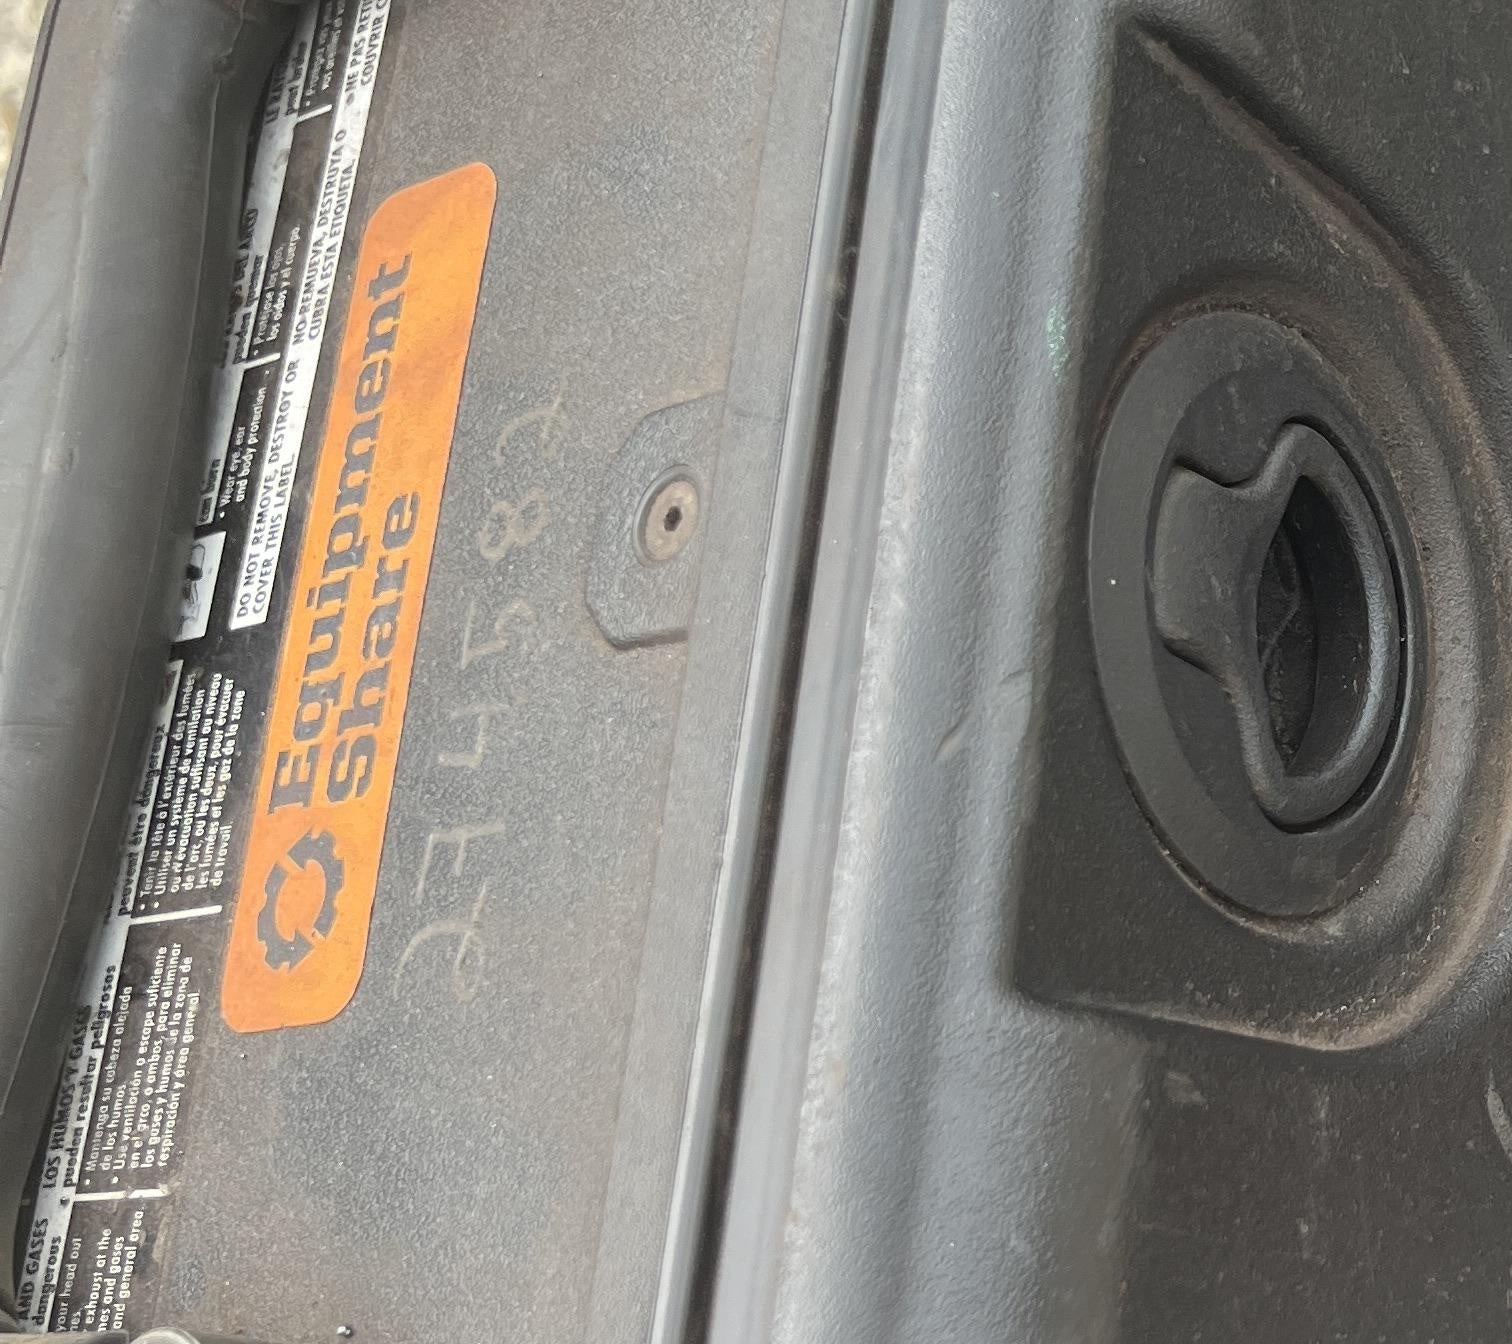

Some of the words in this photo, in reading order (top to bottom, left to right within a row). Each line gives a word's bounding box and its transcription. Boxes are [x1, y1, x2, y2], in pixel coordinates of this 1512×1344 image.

[348, 38, 365, 67] PAS
[359, 14, 385, 86] COUVRIR
[344, 71, 359, 91] NE
[333, 129, 347, 141] O
[316, 145, 344, 227] DESTRUYA
[328, 158, 355, 237] ETIQUETA.
[298, 230, 327, 314] REMUEVA,
[319, 242, 338, 280] ESTA
[307, 282, 330, 340] CUBRA
[292, 319, 308, 344] NO
[284, 358, 300, 383] OR
[267, 389, 294, 463] DESTROY
[218, 474, 236, 507] Wear
[234, 425, 246, 445] ear
[237, 446, 257, 477] body
[232, 478, 248, 503] and
[273, 454, 295, 507] LABEL.
[251, 468, 279, 545] REMOVE,
[264, 513, 283, 551] THIS
[268, 255, 412, 813] Equipment
[242, 551, 260, 586] NOT
[251, 556, 274, 614] COVER
[236, 592, 252, 618] DO
[326, 490, 423, 803] Share
[203, 672, 222, 715] niveau
[213, 677, 235, 727] évacuer
[230, 689, 246, 721] zone
[170, 719, 186, 741] des
[181, 688, 206, 756] ventilation
[201, 717, 213, 735] au
[224, 722, 239, 736] la
[209, 727, 227, 759] pour
[220, 738, 236, 756] de
[177, 757, 192, 774] de
[186, 736, 209, 790] suffisant
[198, 760, 219, 797] deux,
[218, 757, 235, 781] gaz
[166, 776, 190, 826] système
[194, 798, 210, 817] les
[211, 783, 227, 803] les
[209, 804, 223, 818] et
[165, 829, 177, 846] un
[193, 818, 206, 837] ou
[198, 820, 220, 867] fumées
[147, 849, 160, 862] la
[153, 848, 173, 895] Utiliser
[139, 865, 156, 897] Tenir
[170, 875, 182, 892] ou
[180, 873, 195, 891] de
[195, 870, 210, 889] les
[208, 869, 224, 887] de
[142, 945, 169, 1008] suficiente
[159, 941, 183, 998] eliminar
[177, 955, 193, 973] de
[174, 975, 189, 1008] zona
[110, 985, 134, 1035] alejada
[155, 999, 173, 1032] para
[167, 1011, 182, 1025] la
[137, 1009, 157, 1054] escape
[63, 1065, 79, 1081] Y
[101, 1037, 122, 1084] cabeza
[135, 1056, 146, 1066] o
[142, 1034, 166, 1084] ambos,
[154, 1049, 175, 1093] humos
[172, 1046, 190, 1078] área
[57, 1125, 88, 1188] pueden
[86, 963, 121, 1050] peligrosos
[143, 1086, 154, 1095] o
[172, 1079, 186, 1089] y
[101, 1086, 112, 1101] su
[117, 1069, 143, 1141] ventilación
[155, 1095, 168, 1104] y
[48, 1083, 76, 1151] HUMOS
[154, 1091, 184, 1167] respiración
[84, 1103, 111, 1172] Mantenga
[101, 1131, 117, 1150] los
[41, 1155, 61, 1189] LOS
[97, 1153, 112, 1171] de
[111, 1143, 129, 1169] Use
[129, 1151, 141, 1168] en
[139, 1148, 156, 1168] los
[23, 1216, 49, 1275] GASES
[68, 1236, 82, 1259] out
[96, 1227, 112, 1251] the
[94, 1253, 107, 1268] at
[98, 1276, 117, 1305] and
[108, 1234, 128, 1274] gases
[113, 1243, 140, 1300] general
[30, 1234, 65, 1326] dangerous
[58, 1261, 77, 1297] head
[14, 1280, 36, 1321] AND
[80, 1270, 104, 1325] exhaust
[55, 1300, 72, 1331] your
[108, 1301, 126, 1330] and
